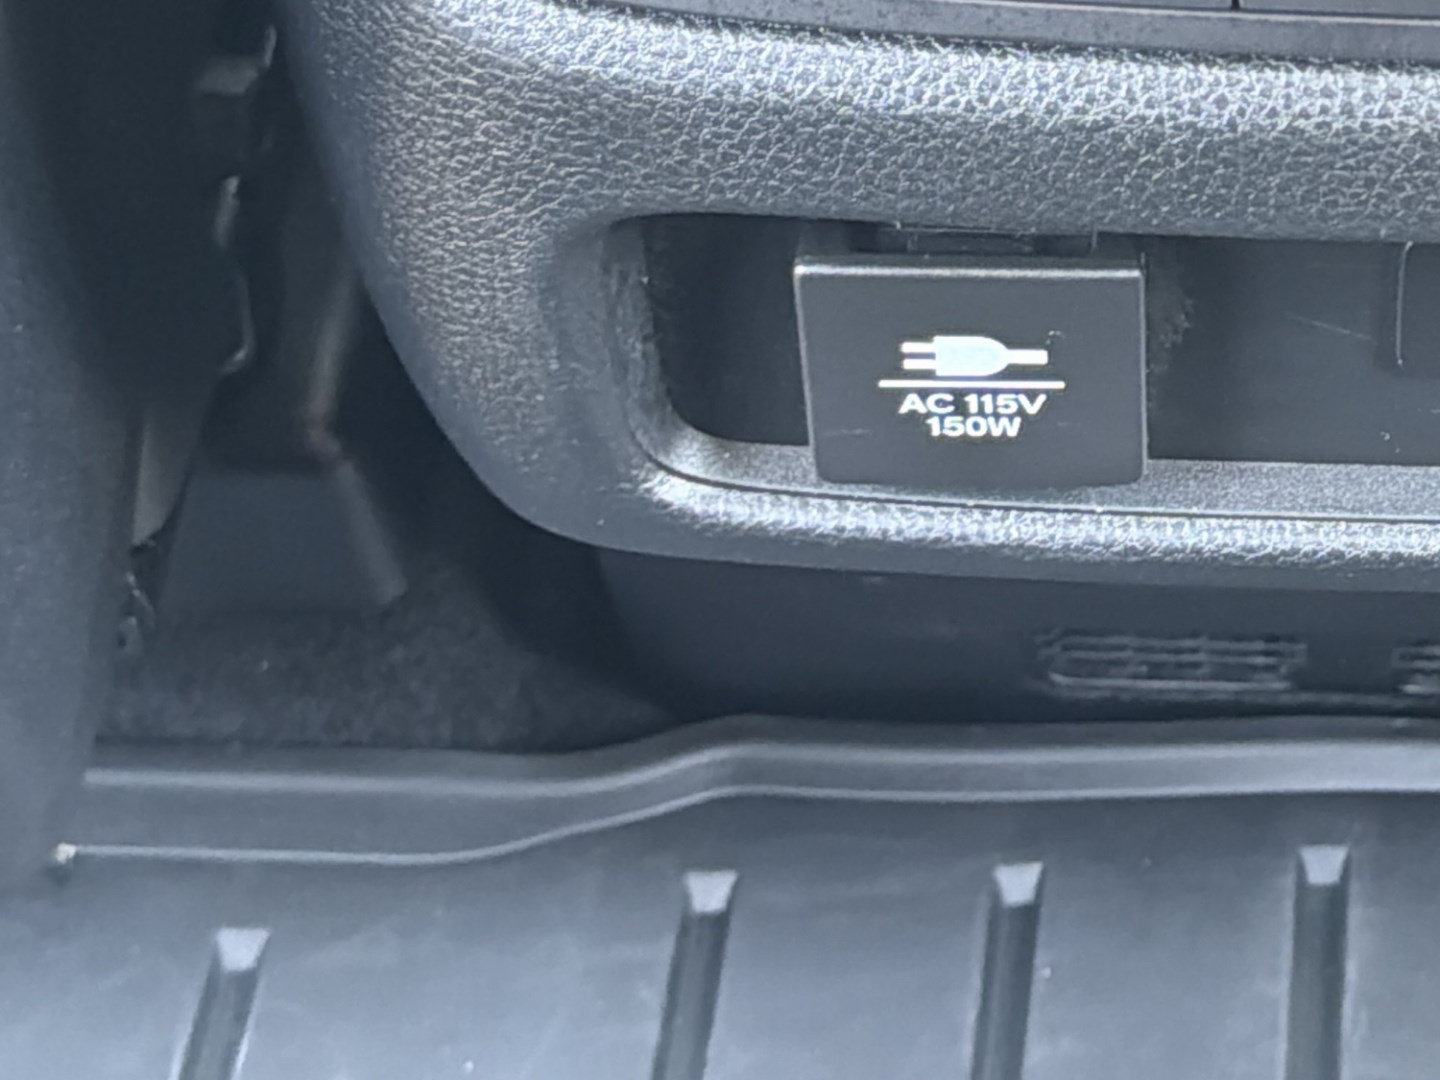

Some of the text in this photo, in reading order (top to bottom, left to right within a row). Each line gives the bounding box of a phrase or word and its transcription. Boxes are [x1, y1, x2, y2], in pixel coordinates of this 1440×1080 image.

[898, 392, 1048, 415] AC 115V
[925, 416, 1022, 438] 150W
